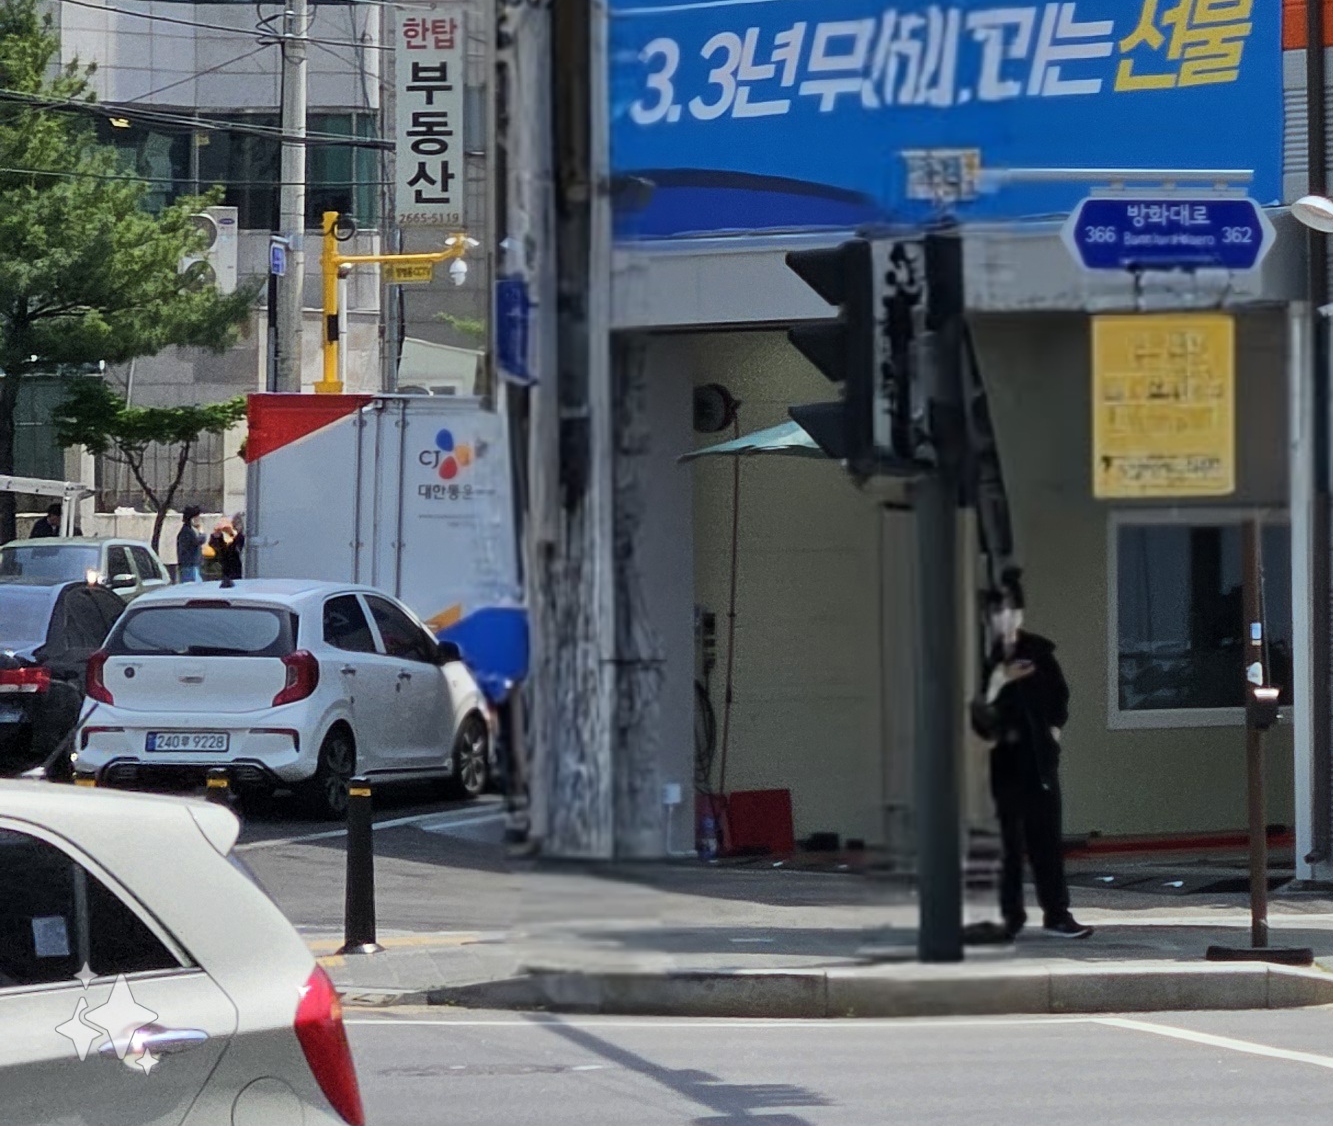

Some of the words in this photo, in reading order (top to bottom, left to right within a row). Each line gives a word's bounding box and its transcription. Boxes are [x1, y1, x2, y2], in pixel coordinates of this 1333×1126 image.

[403, 17, 457, 50] 한탑
[406, 62, 455, 203] 부동산
[1127, 204, 1211, 227] 방화대로
[1085, 226, 1116, 243] 366
[1222, 227, 1252, 243] 362
[419, 450, 441, 469] CJ
[194, 735, 223, 748] 9228
